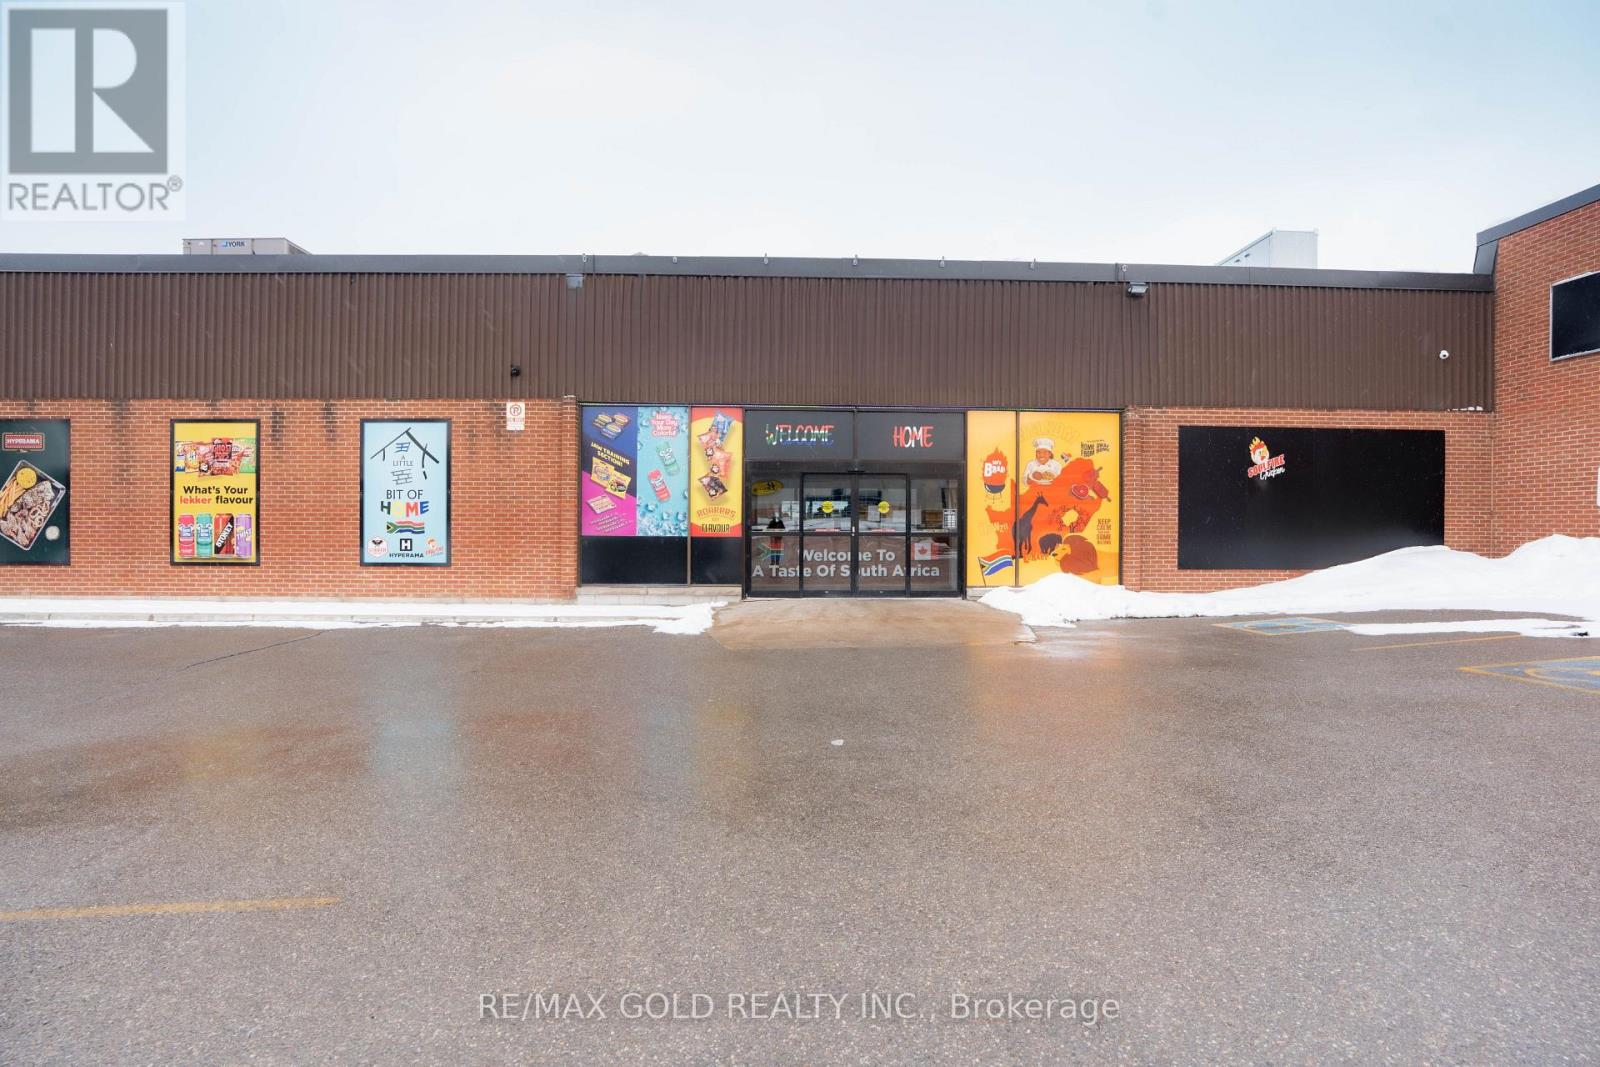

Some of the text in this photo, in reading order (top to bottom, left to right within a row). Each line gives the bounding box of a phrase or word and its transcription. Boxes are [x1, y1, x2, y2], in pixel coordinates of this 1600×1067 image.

[766, 424, 834, 446] WELCOME
[893, 425, 934, 448] HOME
[183, 485, 248, 494] What's Your
[386, 489, 423, 499] BIT OF
[180, 496, 253, 504] lekker flavour
[380, 501, 429, 517] HOME
[876, 549, 896, 561] To
[752, 565, 764, 577] A
[817, 565, 836, 577] Of
[841, 564, 888, 577] Suth
[892, 564, 940, 577] Arica
